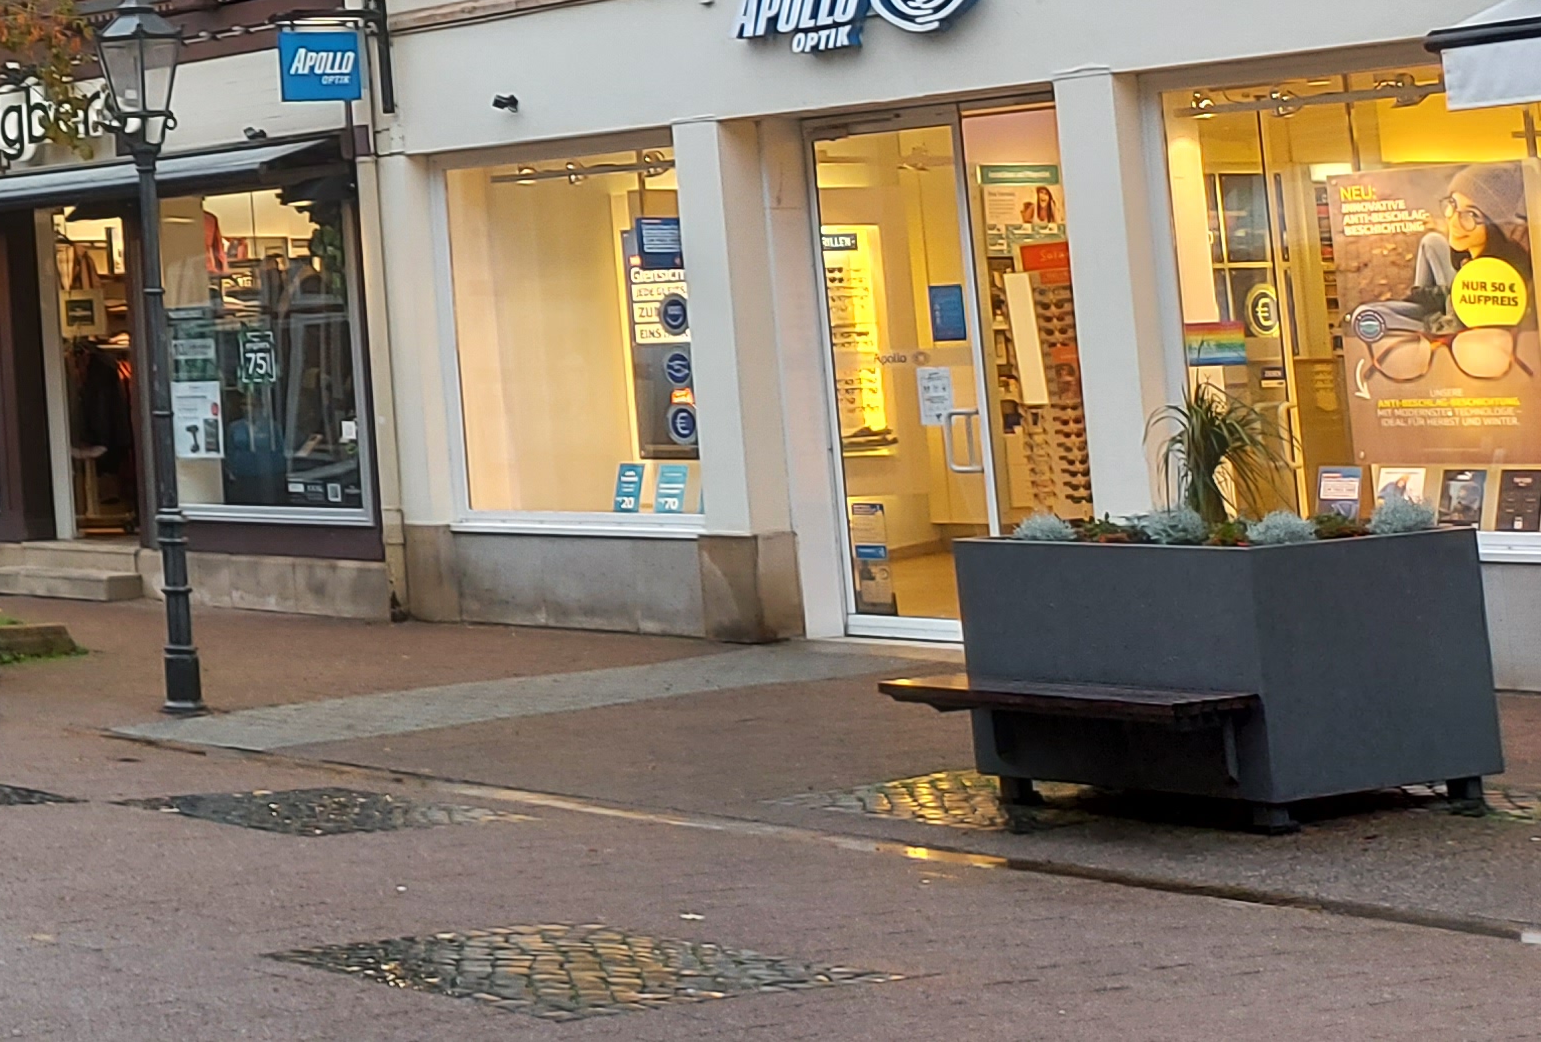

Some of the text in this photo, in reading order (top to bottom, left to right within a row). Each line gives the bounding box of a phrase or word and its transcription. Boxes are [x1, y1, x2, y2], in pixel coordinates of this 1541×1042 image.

[791, 24, 854, 54] OPTIK
[289, 47, 356, 75] APOLLO
[321, 75, 352, 85] OPTIK
[1340, 185, 1376, 201] NEU:
[1341, 199, 1406, 214] INNOVATIVE
[1344, 221, 1425, 236] BESCHICHTUNG
[1461, 280, 1487, 292] NUR
[1491, 282, 1506, 292] 50
[1459, 294, 1519, 307] AUFPREIS
